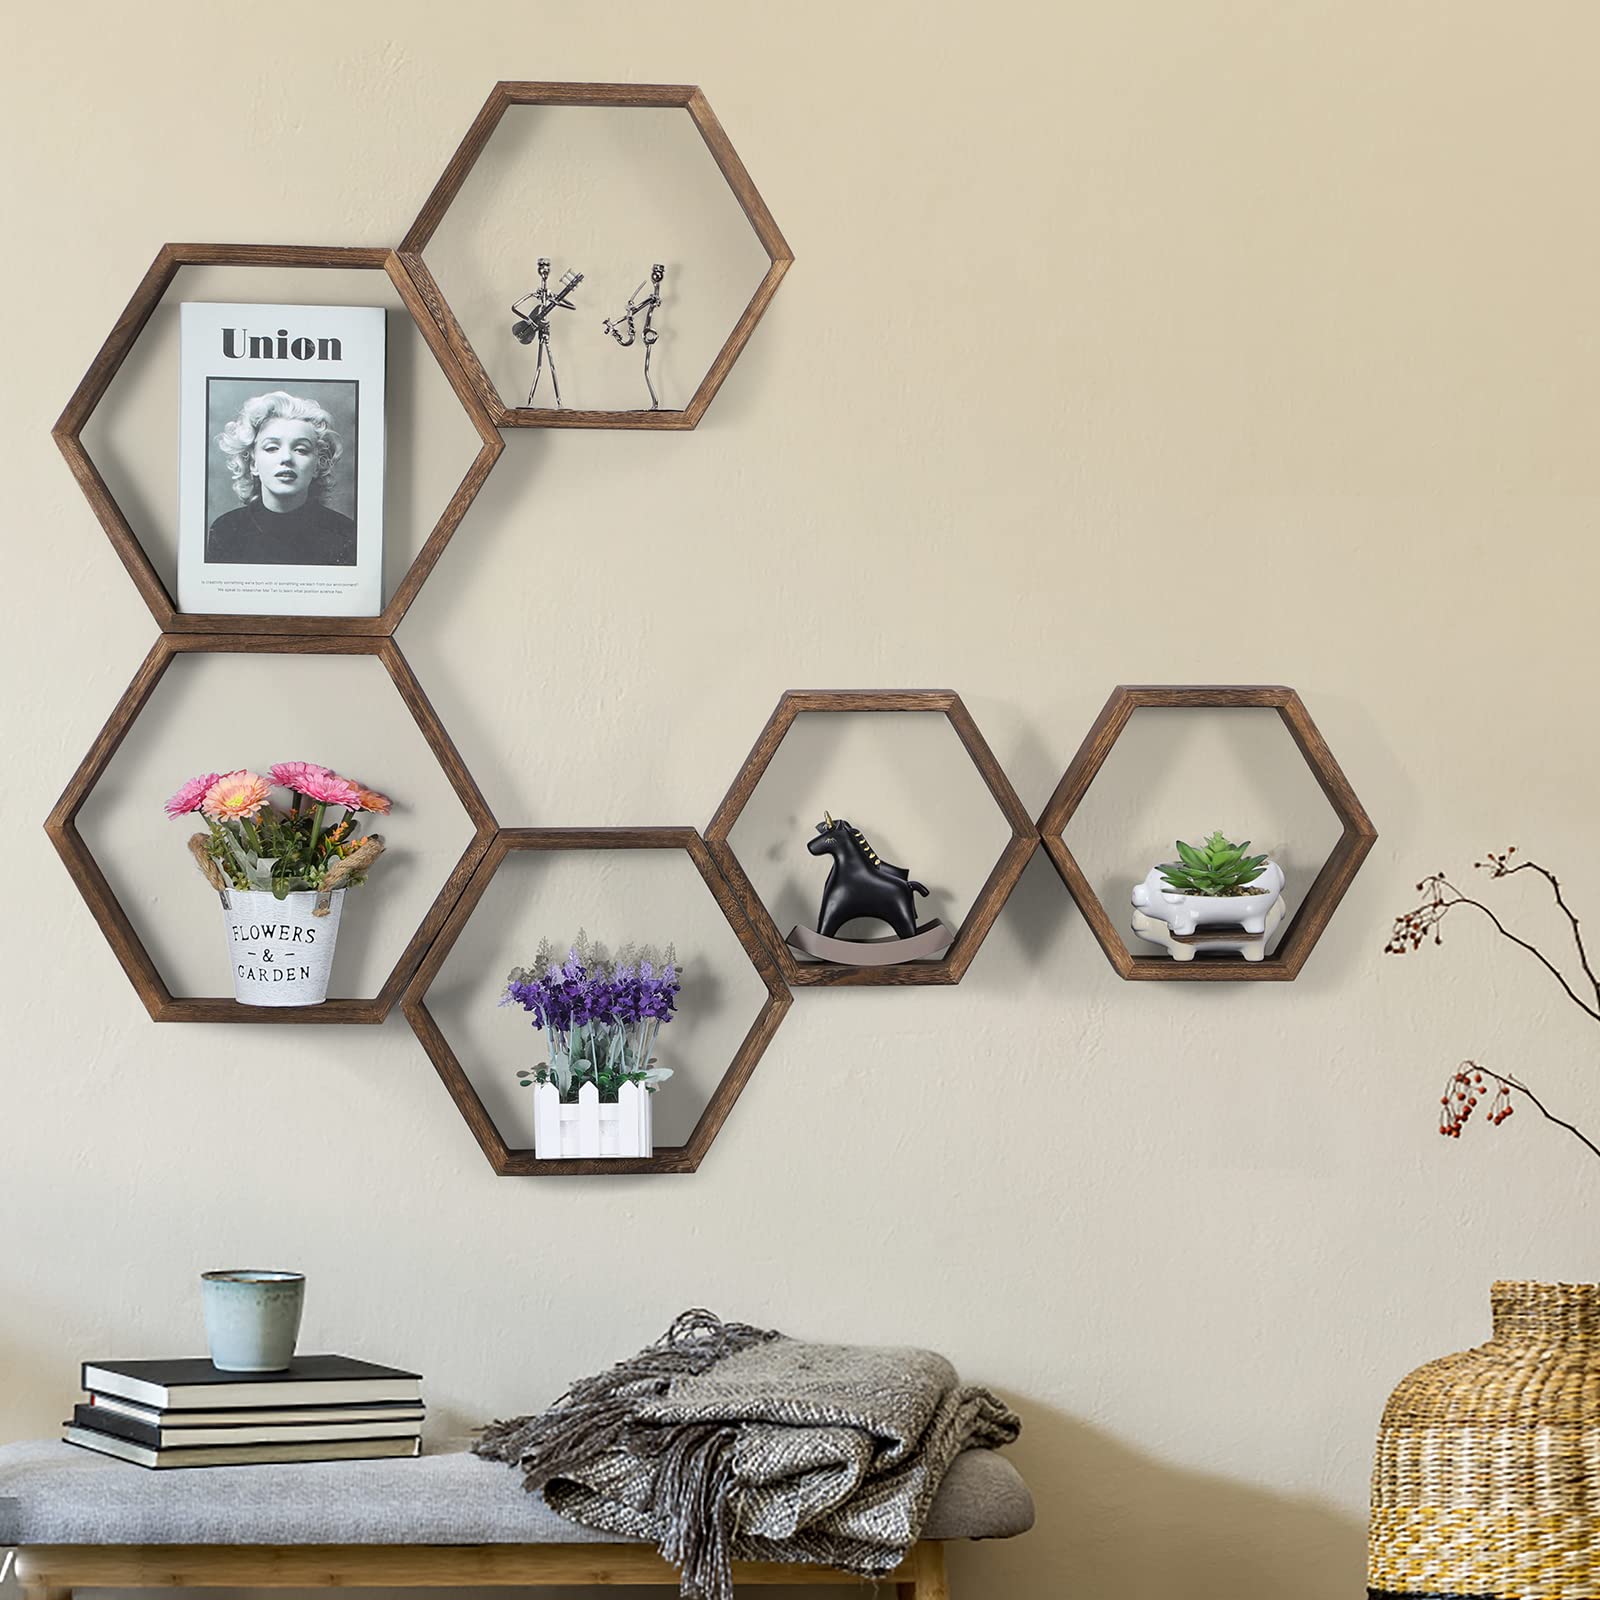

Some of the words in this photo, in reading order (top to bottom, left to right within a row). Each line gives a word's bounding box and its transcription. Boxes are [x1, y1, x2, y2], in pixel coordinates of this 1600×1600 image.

[221, 328, 342, 360] Union
[232, 924, 316, 944] FLOWERS
[238, 964, 310, 982] GARDEN
